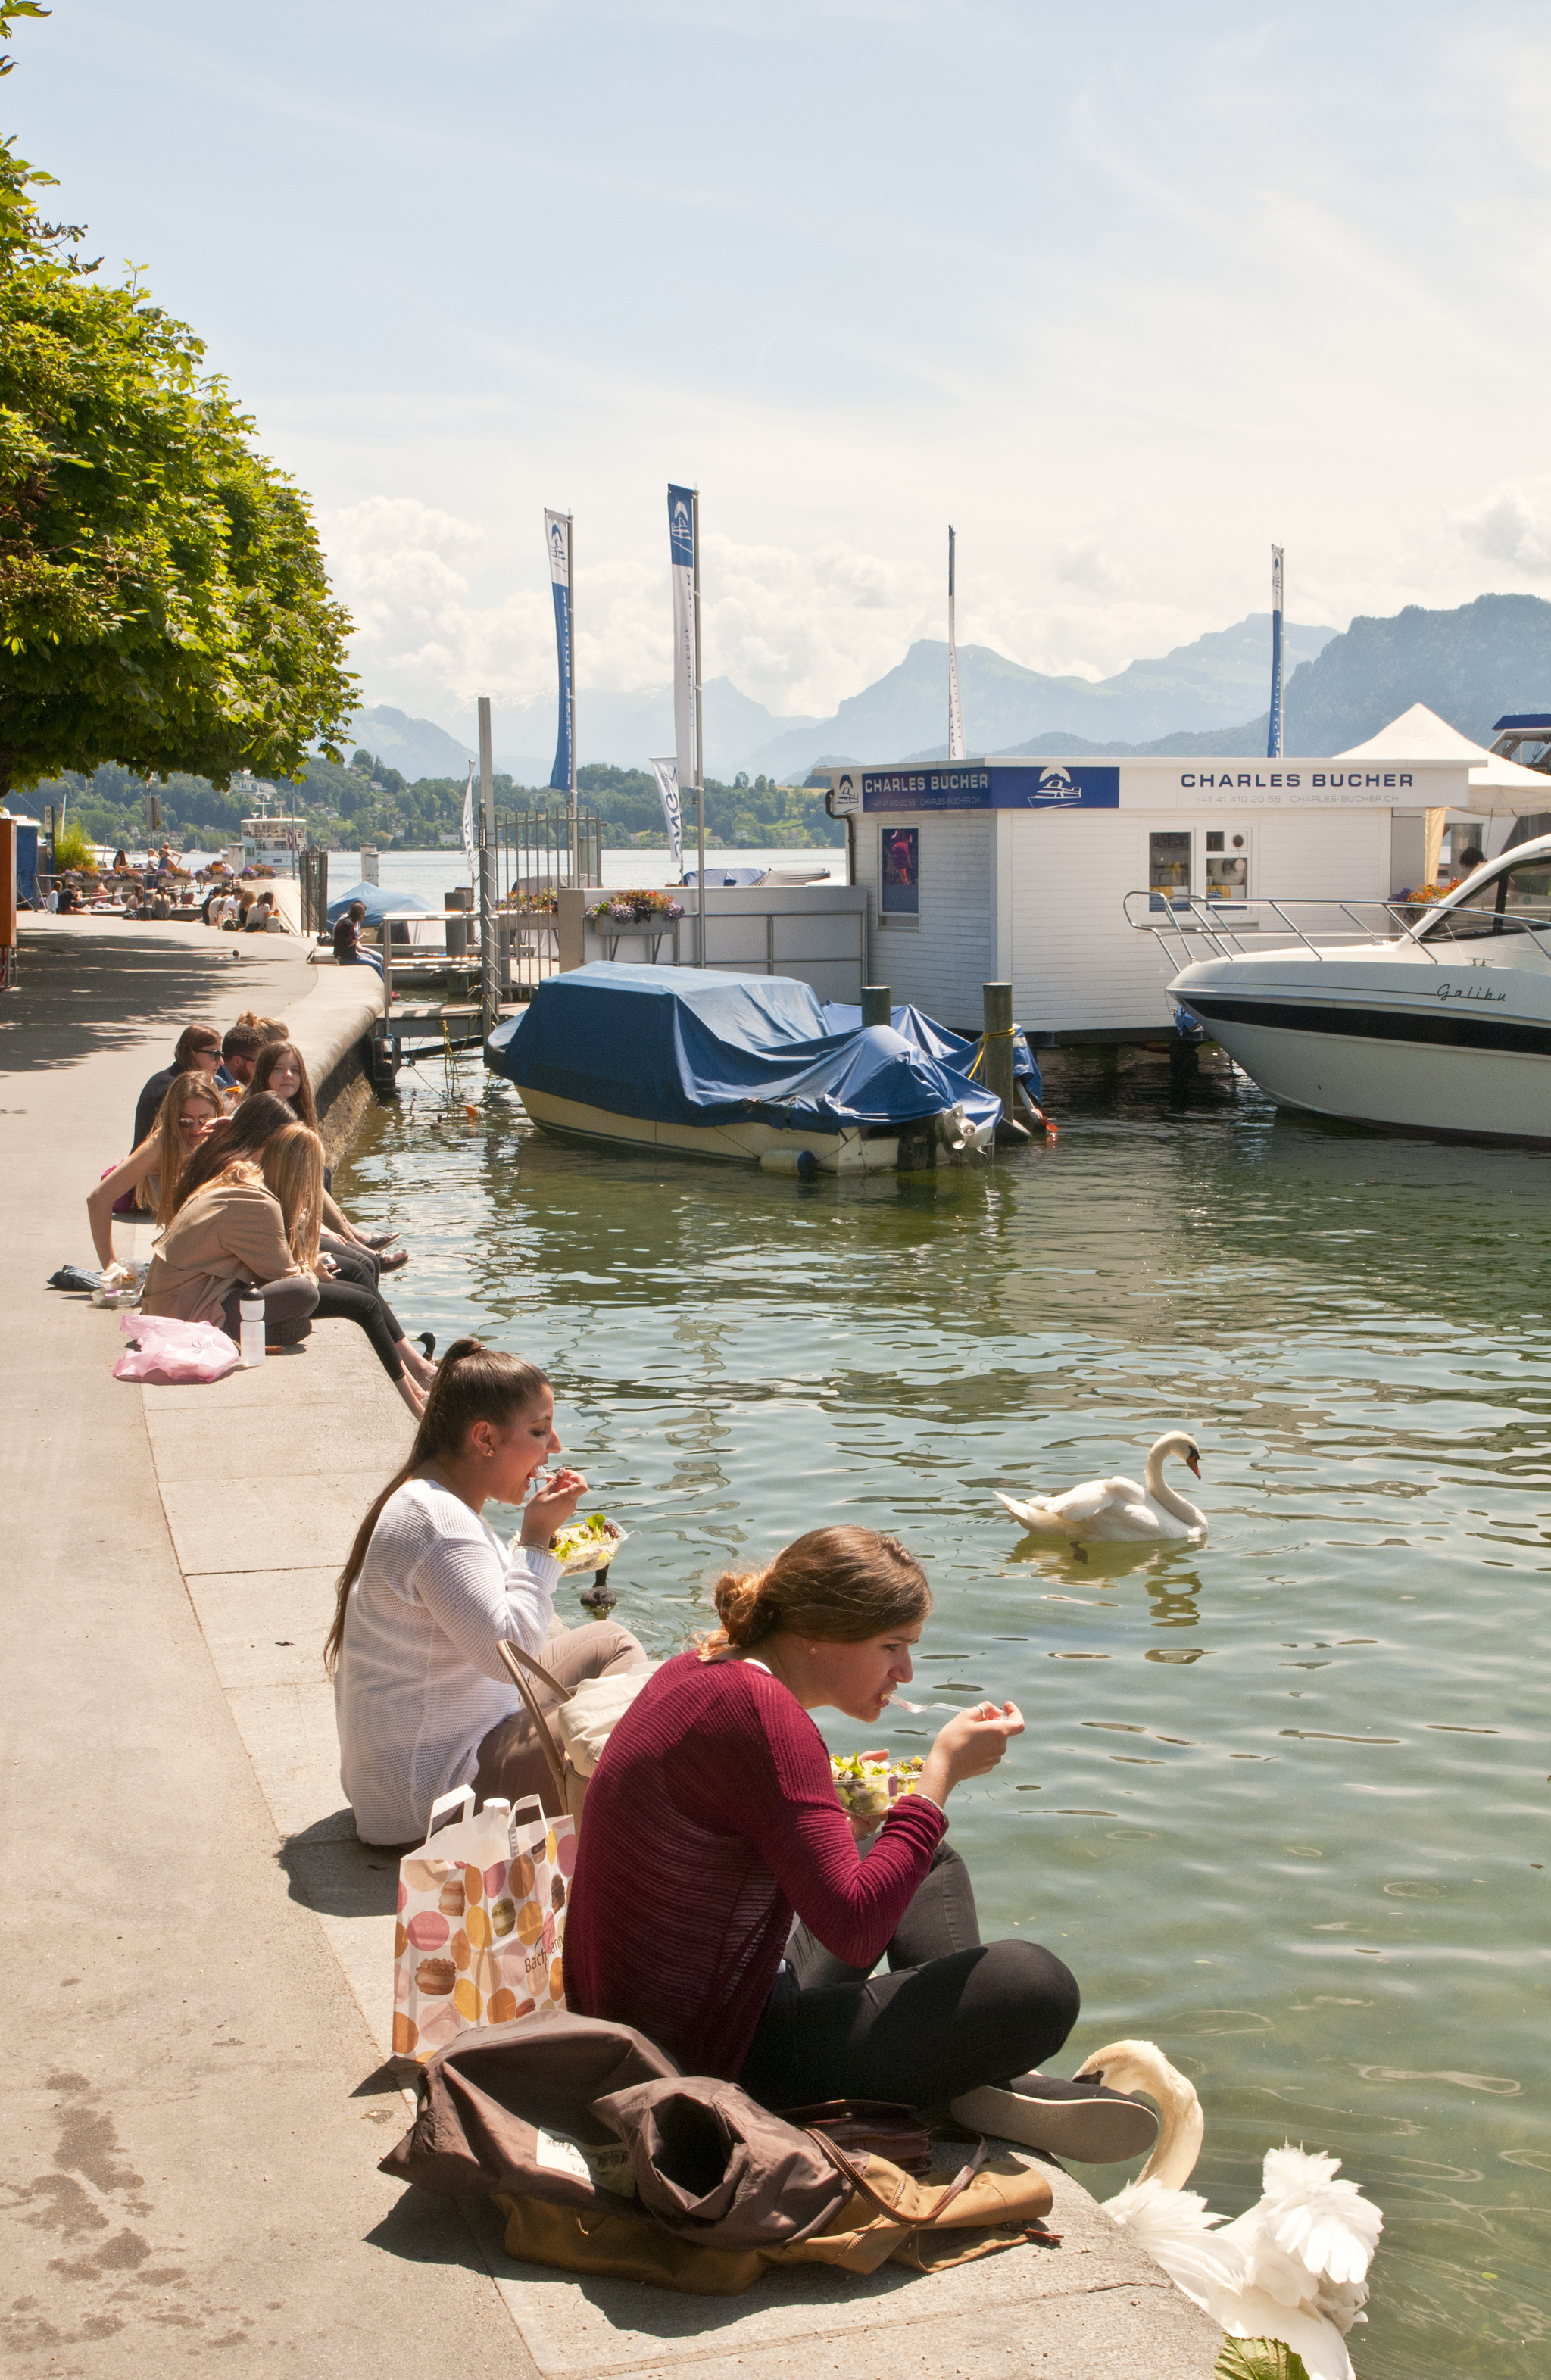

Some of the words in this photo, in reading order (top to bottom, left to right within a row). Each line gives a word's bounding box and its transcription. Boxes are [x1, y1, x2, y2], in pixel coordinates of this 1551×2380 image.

[865, 776, 925, 793] CHARLES
[931, 774, 988, 790] BUCHER
[1181, 774, 1300, 788] CHARLES
[1312, 774, 1413, 788] BUCHER
